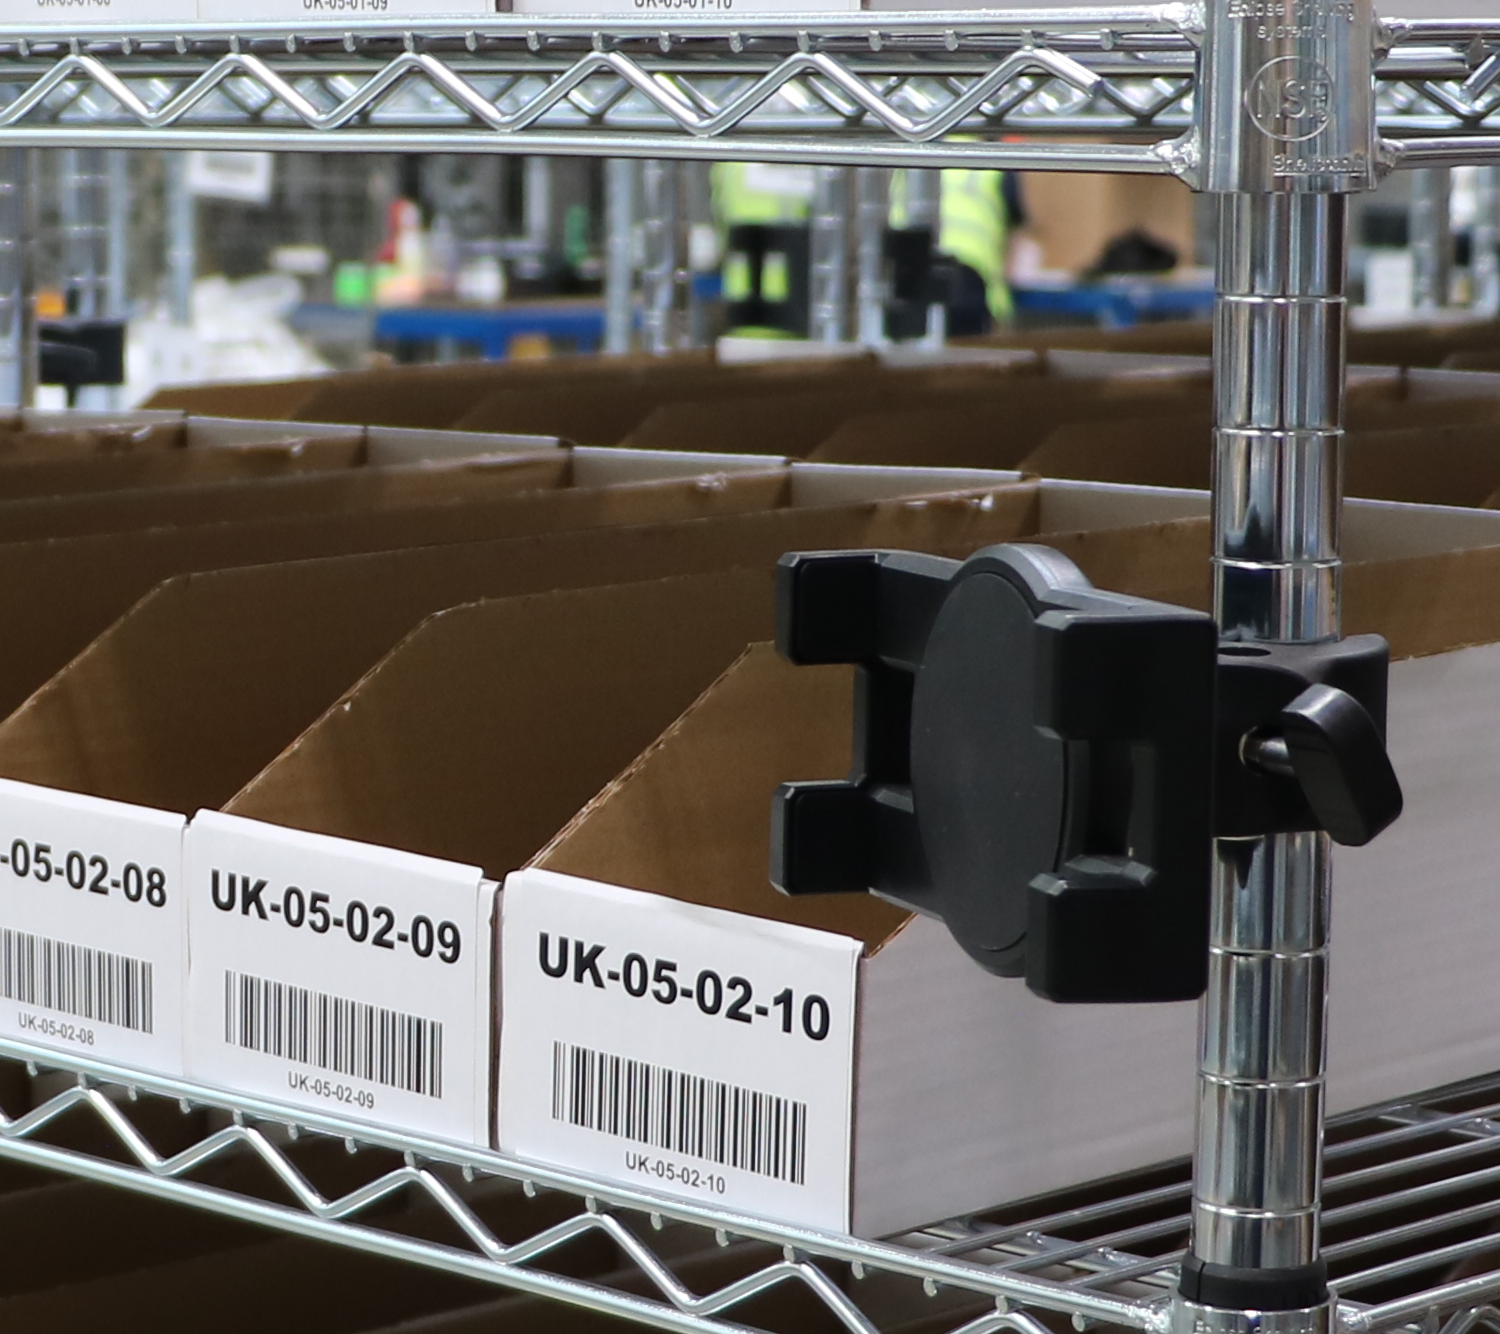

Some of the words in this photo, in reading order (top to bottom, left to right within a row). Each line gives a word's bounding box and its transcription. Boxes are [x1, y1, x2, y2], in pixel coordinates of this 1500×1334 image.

[211, 869, 461, 965] UK-05-02-09
[538, 932, 831, 1042] UK-05-02-10
[18, 1011, 95, 1046] UK-05-02-08
[288, 1070, 375, 1110] UK-05-02-09
[625, 1151, 726, 1195] UK-05-02-10
